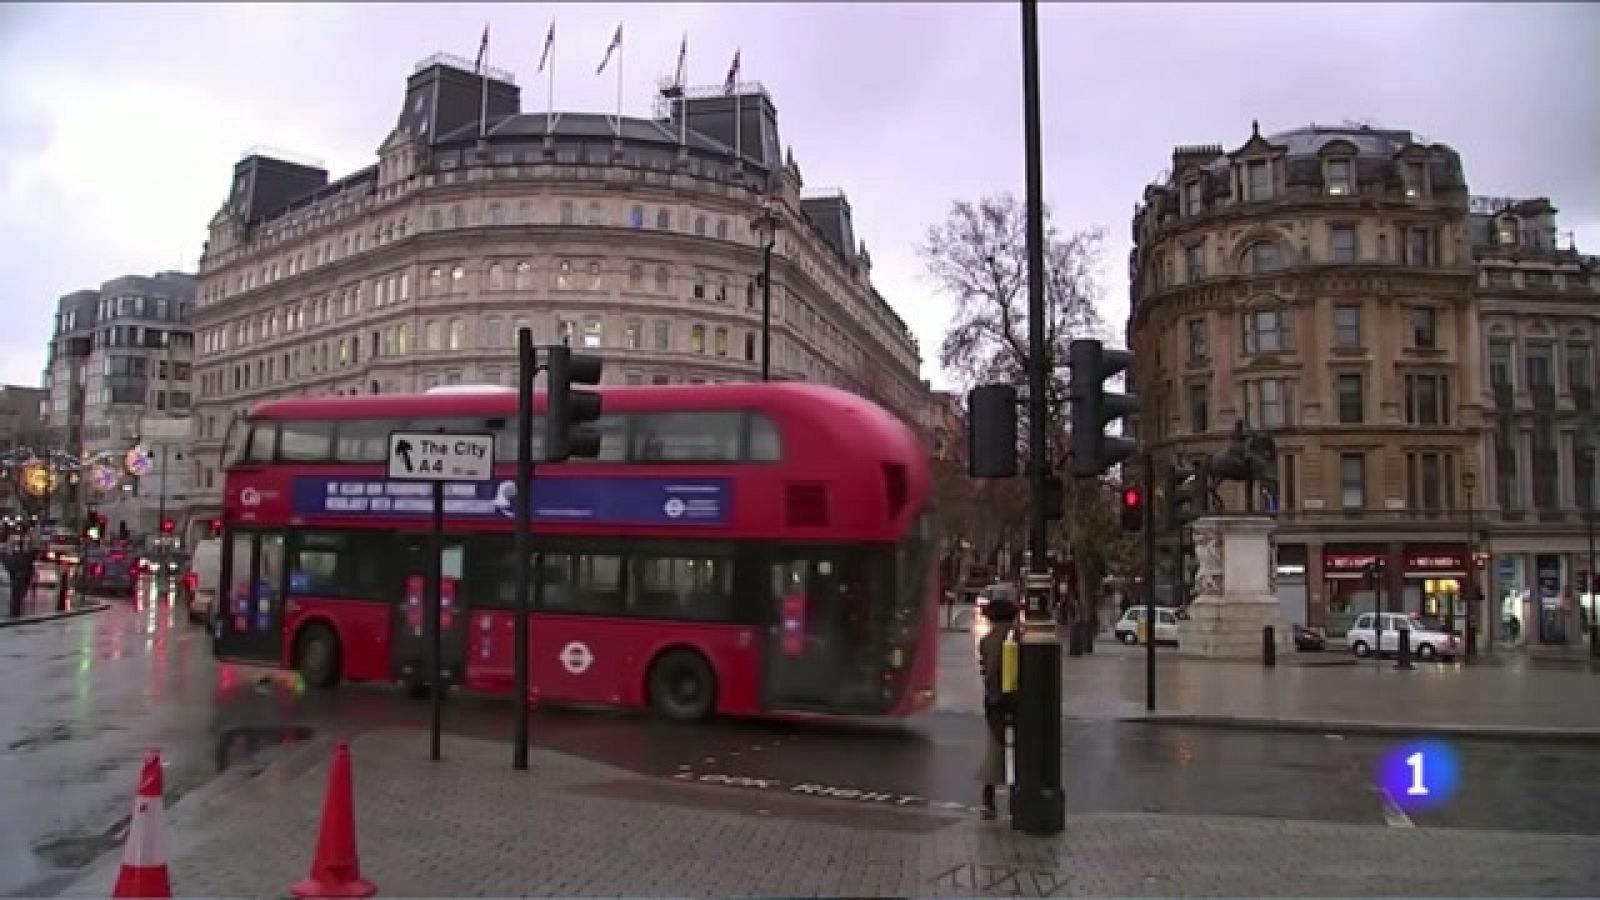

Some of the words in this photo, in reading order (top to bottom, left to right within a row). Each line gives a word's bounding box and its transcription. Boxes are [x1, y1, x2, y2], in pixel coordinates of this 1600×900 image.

[420, 439, 448, 455] The
[454, 440, 488, 460] City
[418, 459, 443, 473] A4
[671, 768, 779, 788] LOOK
[790, 784, 926, 806] RIGHT
